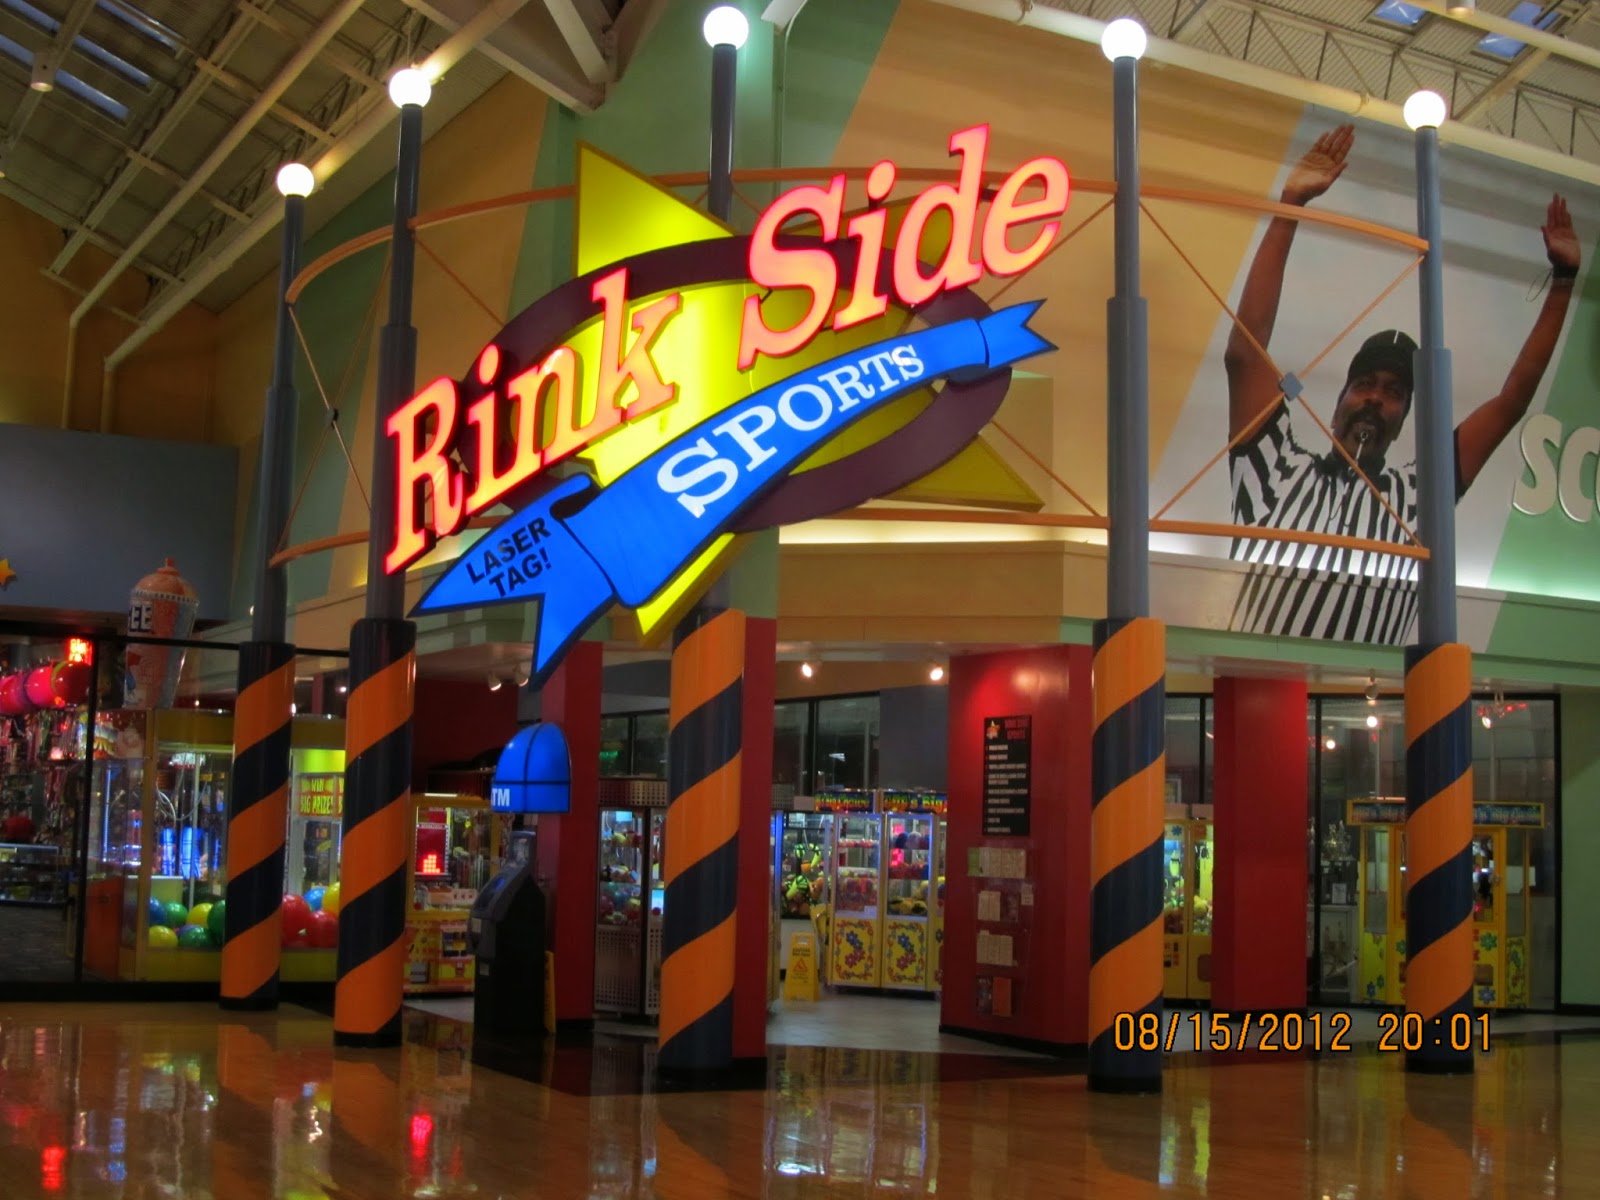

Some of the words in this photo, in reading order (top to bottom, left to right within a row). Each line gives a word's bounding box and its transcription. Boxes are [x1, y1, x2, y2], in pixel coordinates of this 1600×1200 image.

[385, 267, 683, 575] Rink
[737, 122, 1071, 371] Side
[656, 344, 925, 519] SPORTS
[1512, 413, 1600, 523] SC
[465, 517, 552, 585] LASER
[488, 547, 552, 597] TAG!
